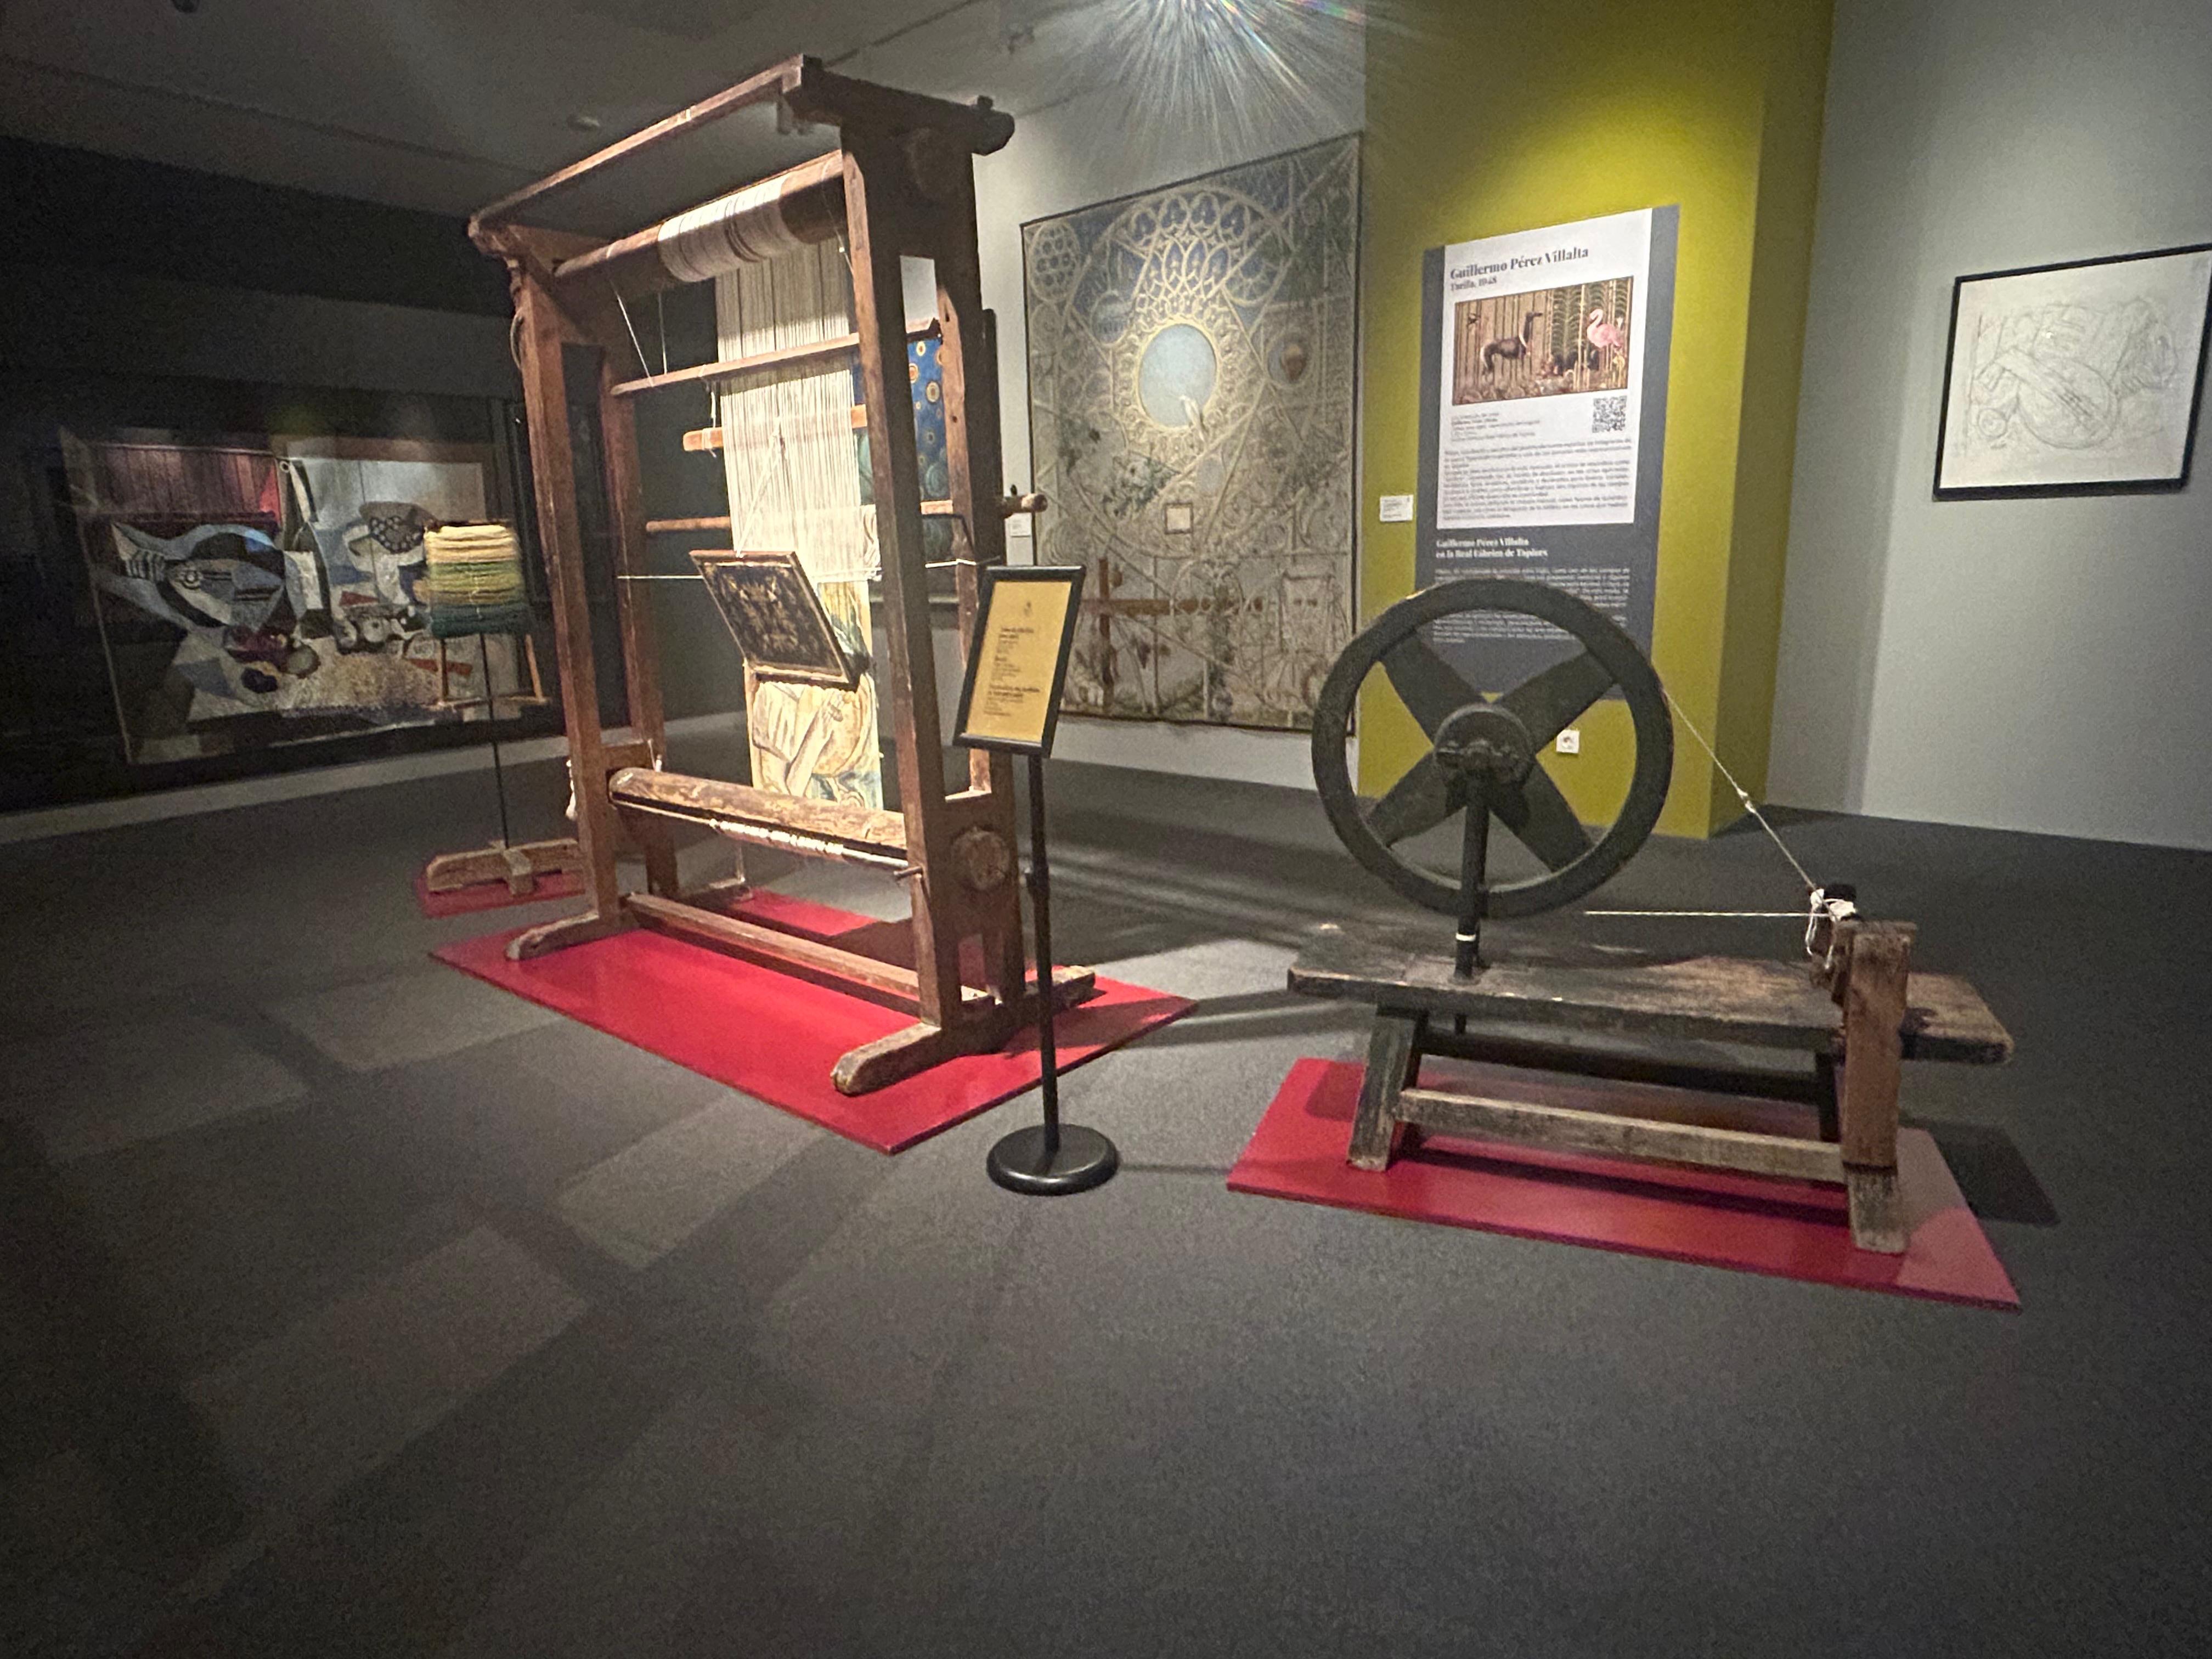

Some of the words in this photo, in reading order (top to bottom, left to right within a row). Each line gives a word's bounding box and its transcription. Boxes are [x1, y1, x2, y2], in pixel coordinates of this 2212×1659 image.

[1451, 262, 1508, 279] Guillermo
[1510, 255, 1542, 270] Pérez
[1545, 247, 1589, 263] Villalta
